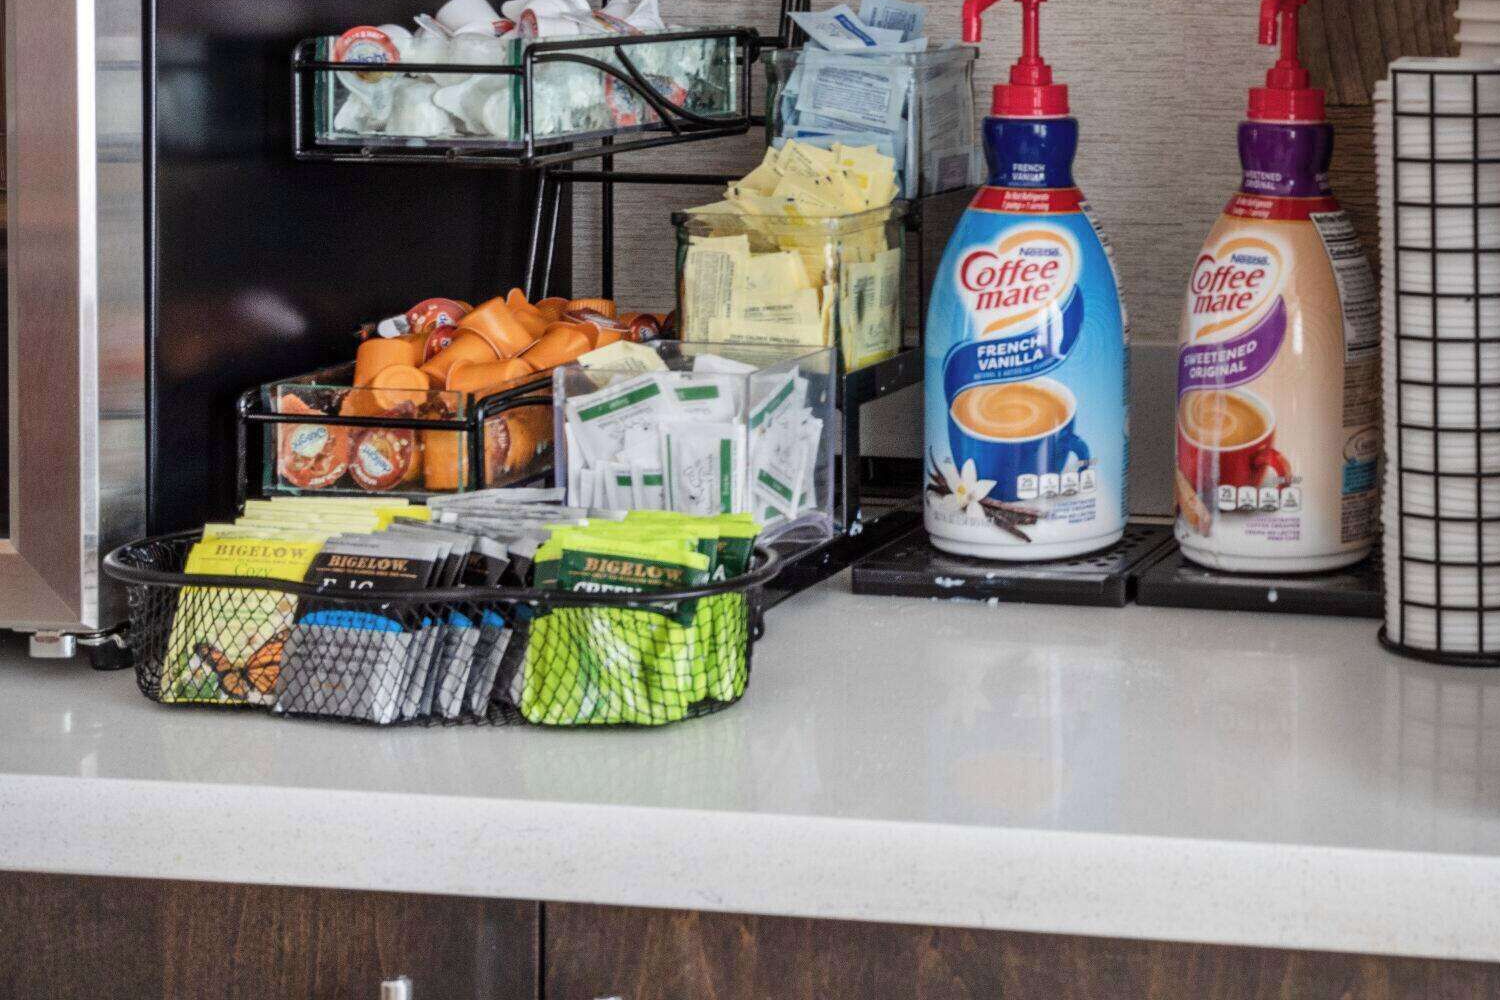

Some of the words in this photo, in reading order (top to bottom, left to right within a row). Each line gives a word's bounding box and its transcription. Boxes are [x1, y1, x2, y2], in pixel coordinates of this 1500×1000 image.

[1012, 162, 1046, 172] FRENCH
[960, 249, 1060, 292] Coffee
[1191, 253, 1265, 295] Coffee
[975, 282, 1051, 311] mate
[1193, 292, 1253, 314] mate
[976, 335, 1043, 359] FRENCH
[1183, 340, 1258, 366] SWEETENED
[977, 348, 1044, 371] VANILLA
[1188, 360, 1247, 379] ORIGINAL
[214, 543, 308, 560] BIGELOW
[327, 554, 409, 572] BIGELOW
[233, 564, 273, 577] Cozy
[583, 556, 684, 580] BIGELOW
